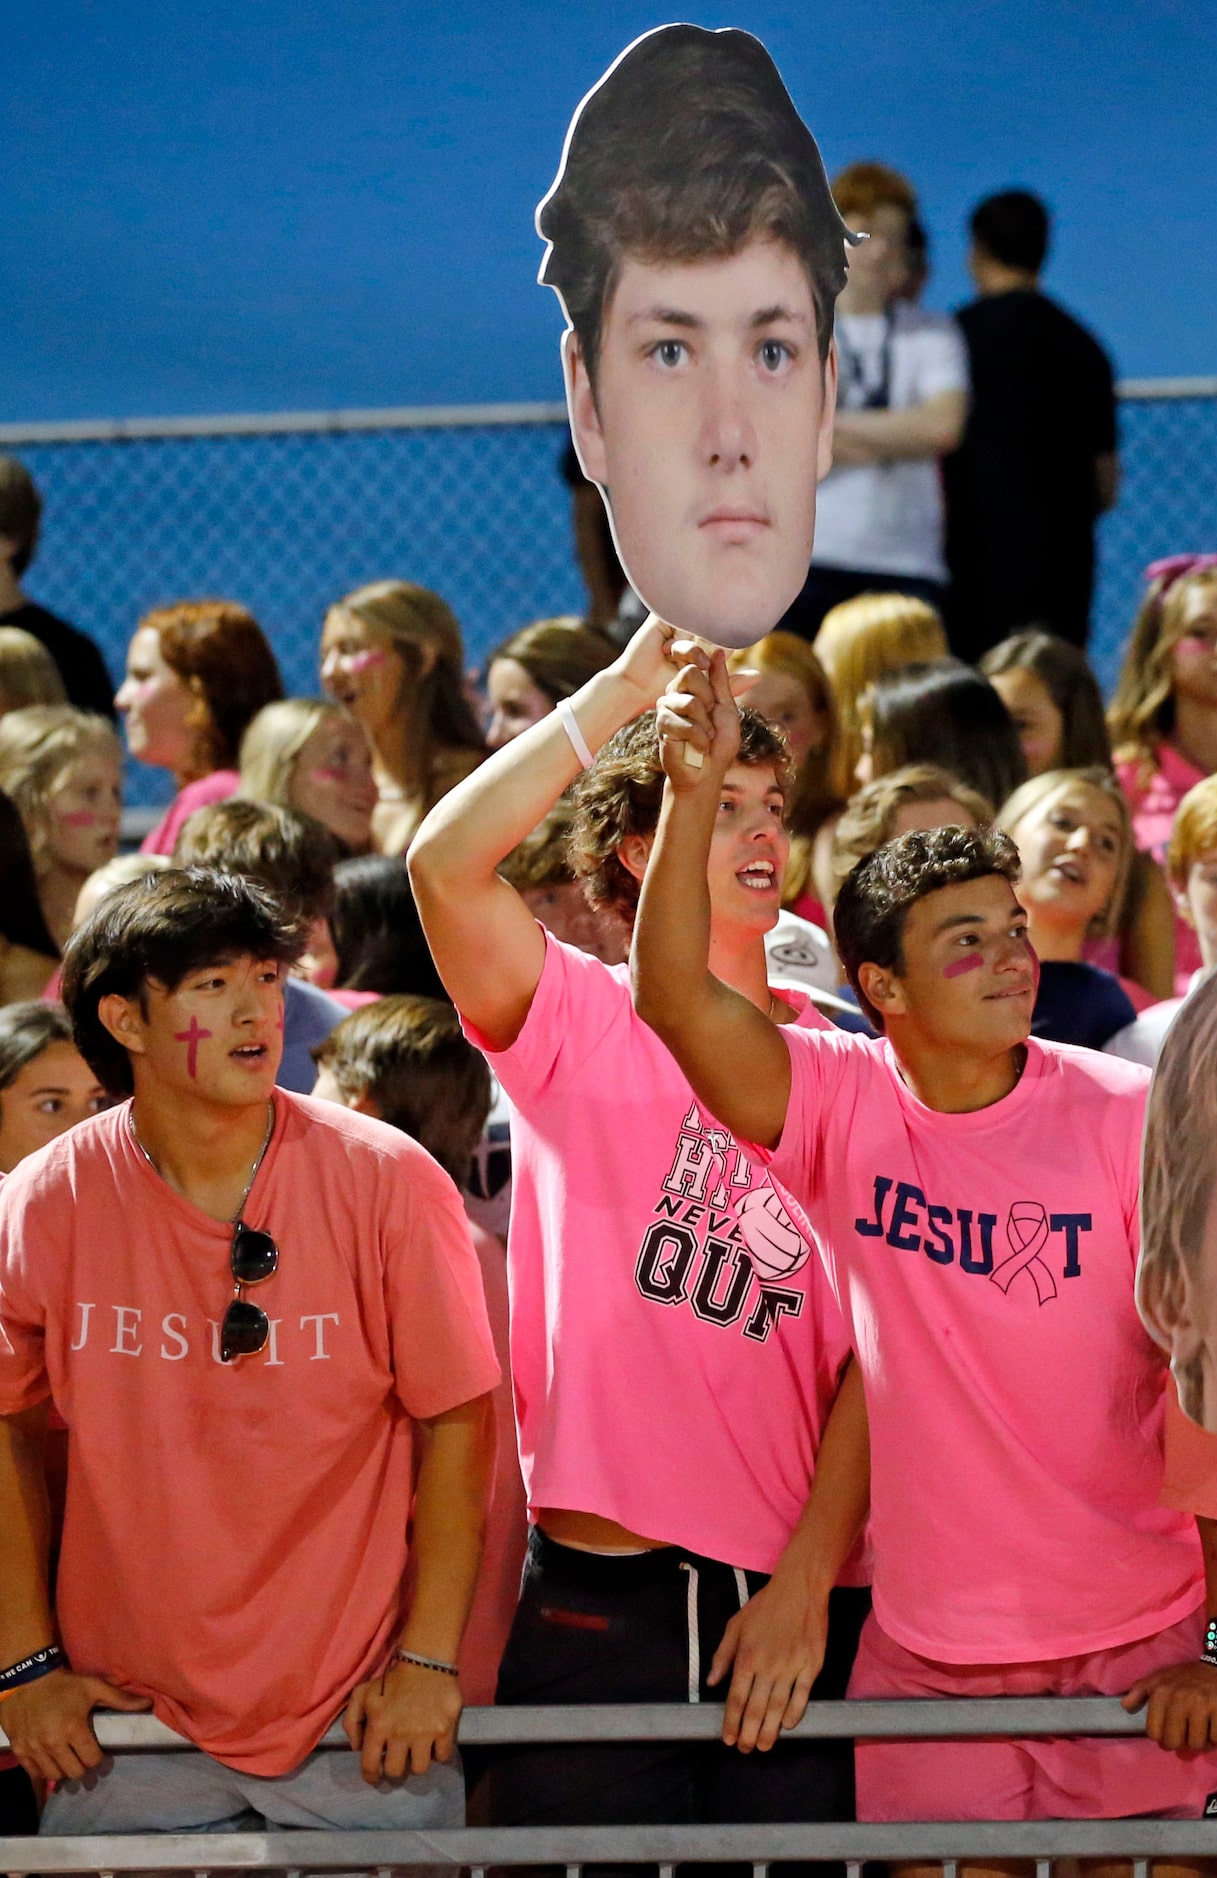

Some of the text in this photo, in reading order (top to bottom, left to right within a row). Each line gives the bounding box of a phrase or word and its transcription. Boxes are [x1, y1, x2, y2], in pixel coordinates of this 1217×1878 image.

[654, 1195, 744, 1244] NEVE
[5, 1669, 17, 1679] WE
[15, 1660, 33, 1672] CAN
